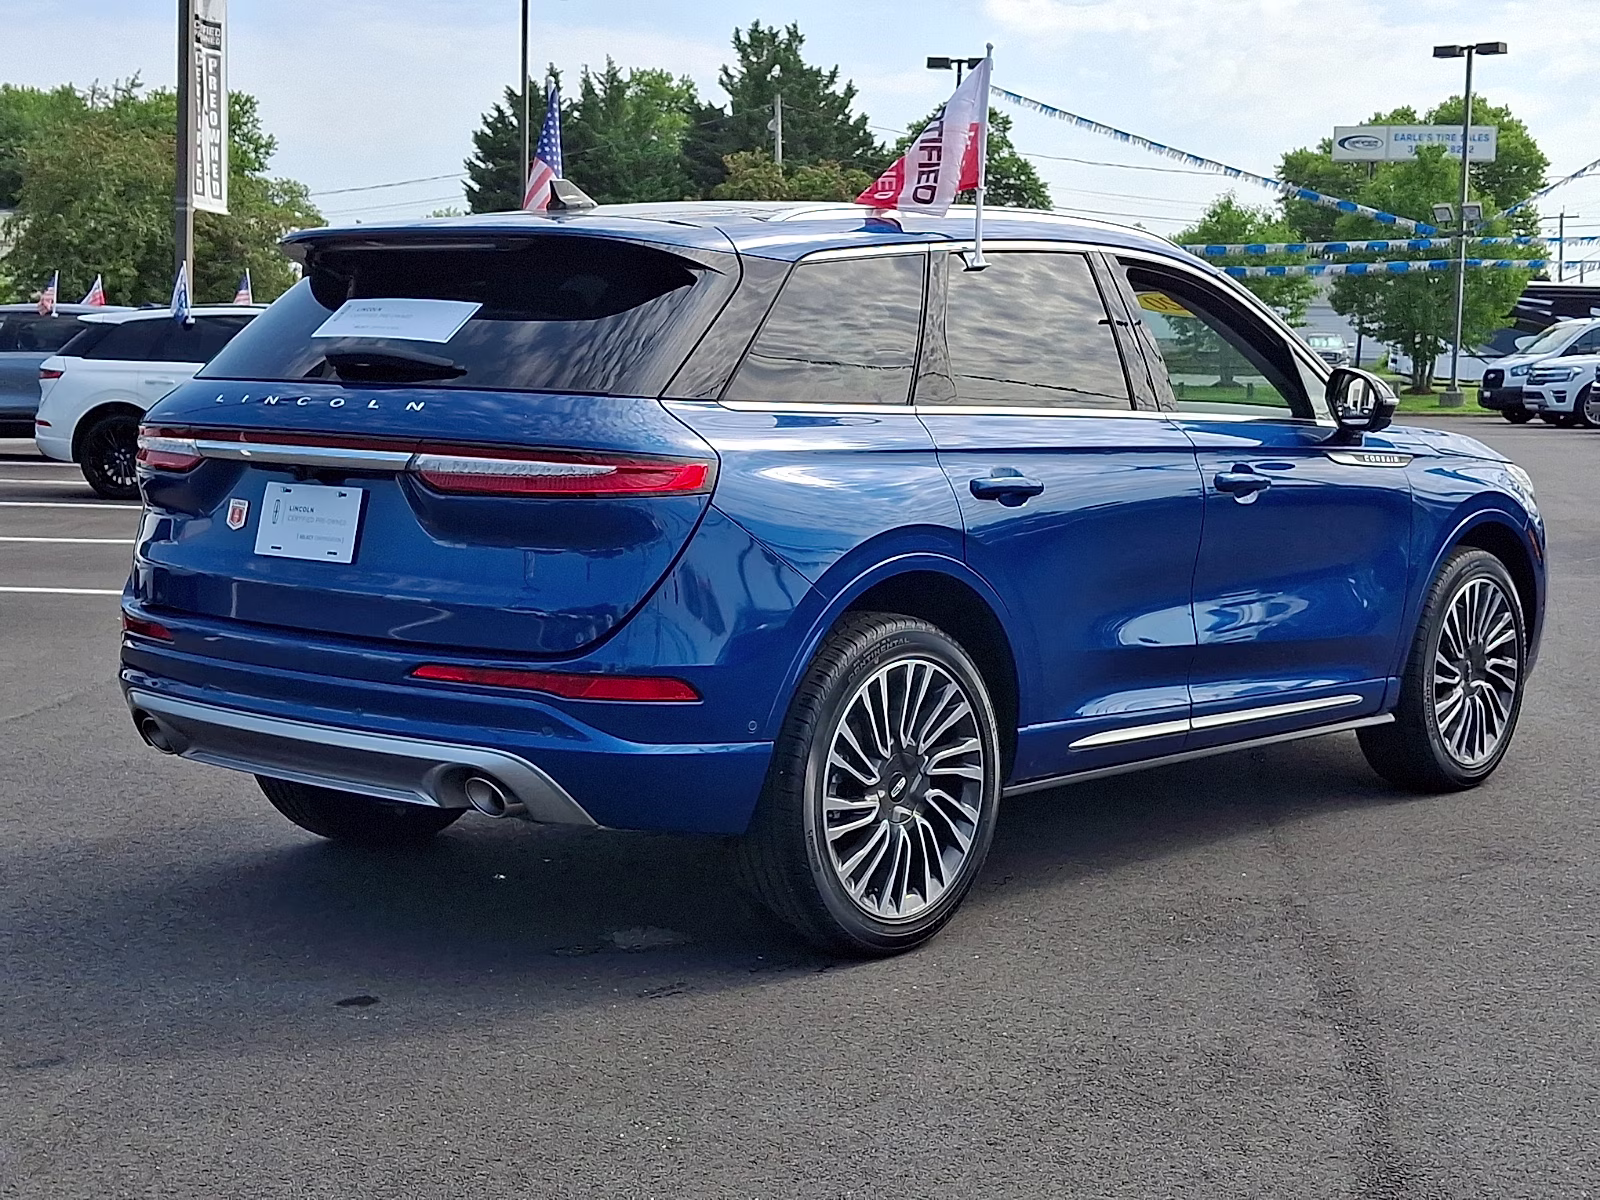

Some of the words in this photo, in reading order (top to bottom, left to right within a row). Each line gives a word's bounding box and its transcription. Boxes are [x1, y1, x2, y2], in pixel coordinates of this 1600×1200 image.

[208, 57, 221, 196] PREOWNED
[1394, 133, 1432, 142] EARLE'S
[1436, 133, 1456, 142] TIRE
[216, 394, 425, 411] LINCOLN
[289, 505, 315, 513] LINCOLN
